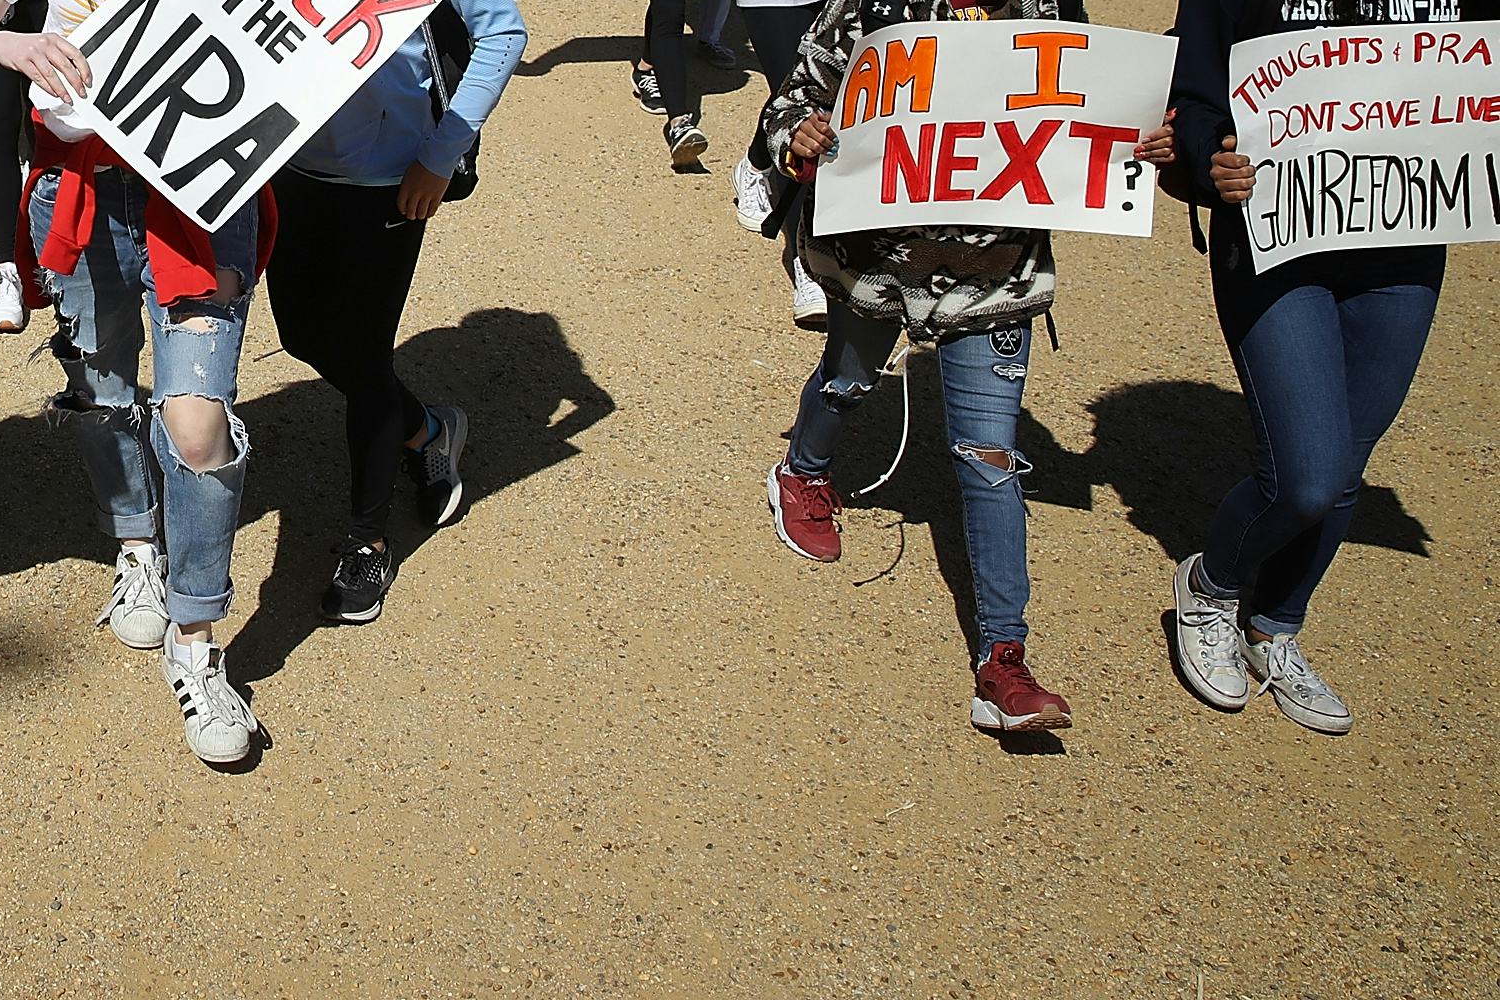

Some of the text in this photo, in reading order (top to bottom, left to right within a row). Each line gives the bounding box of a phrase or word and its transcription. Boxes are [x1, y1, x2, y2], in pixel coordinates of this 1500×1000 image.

[840, 32, 1089, 130] AM I
[1231, 37, 1383, 115] THOUGHTS
[1414, 32, 1493, 65] PRA
[880, 119, 1143, 212] NEXT?
[1268, 95, 1500, 148] DONT SAVE LIVE
